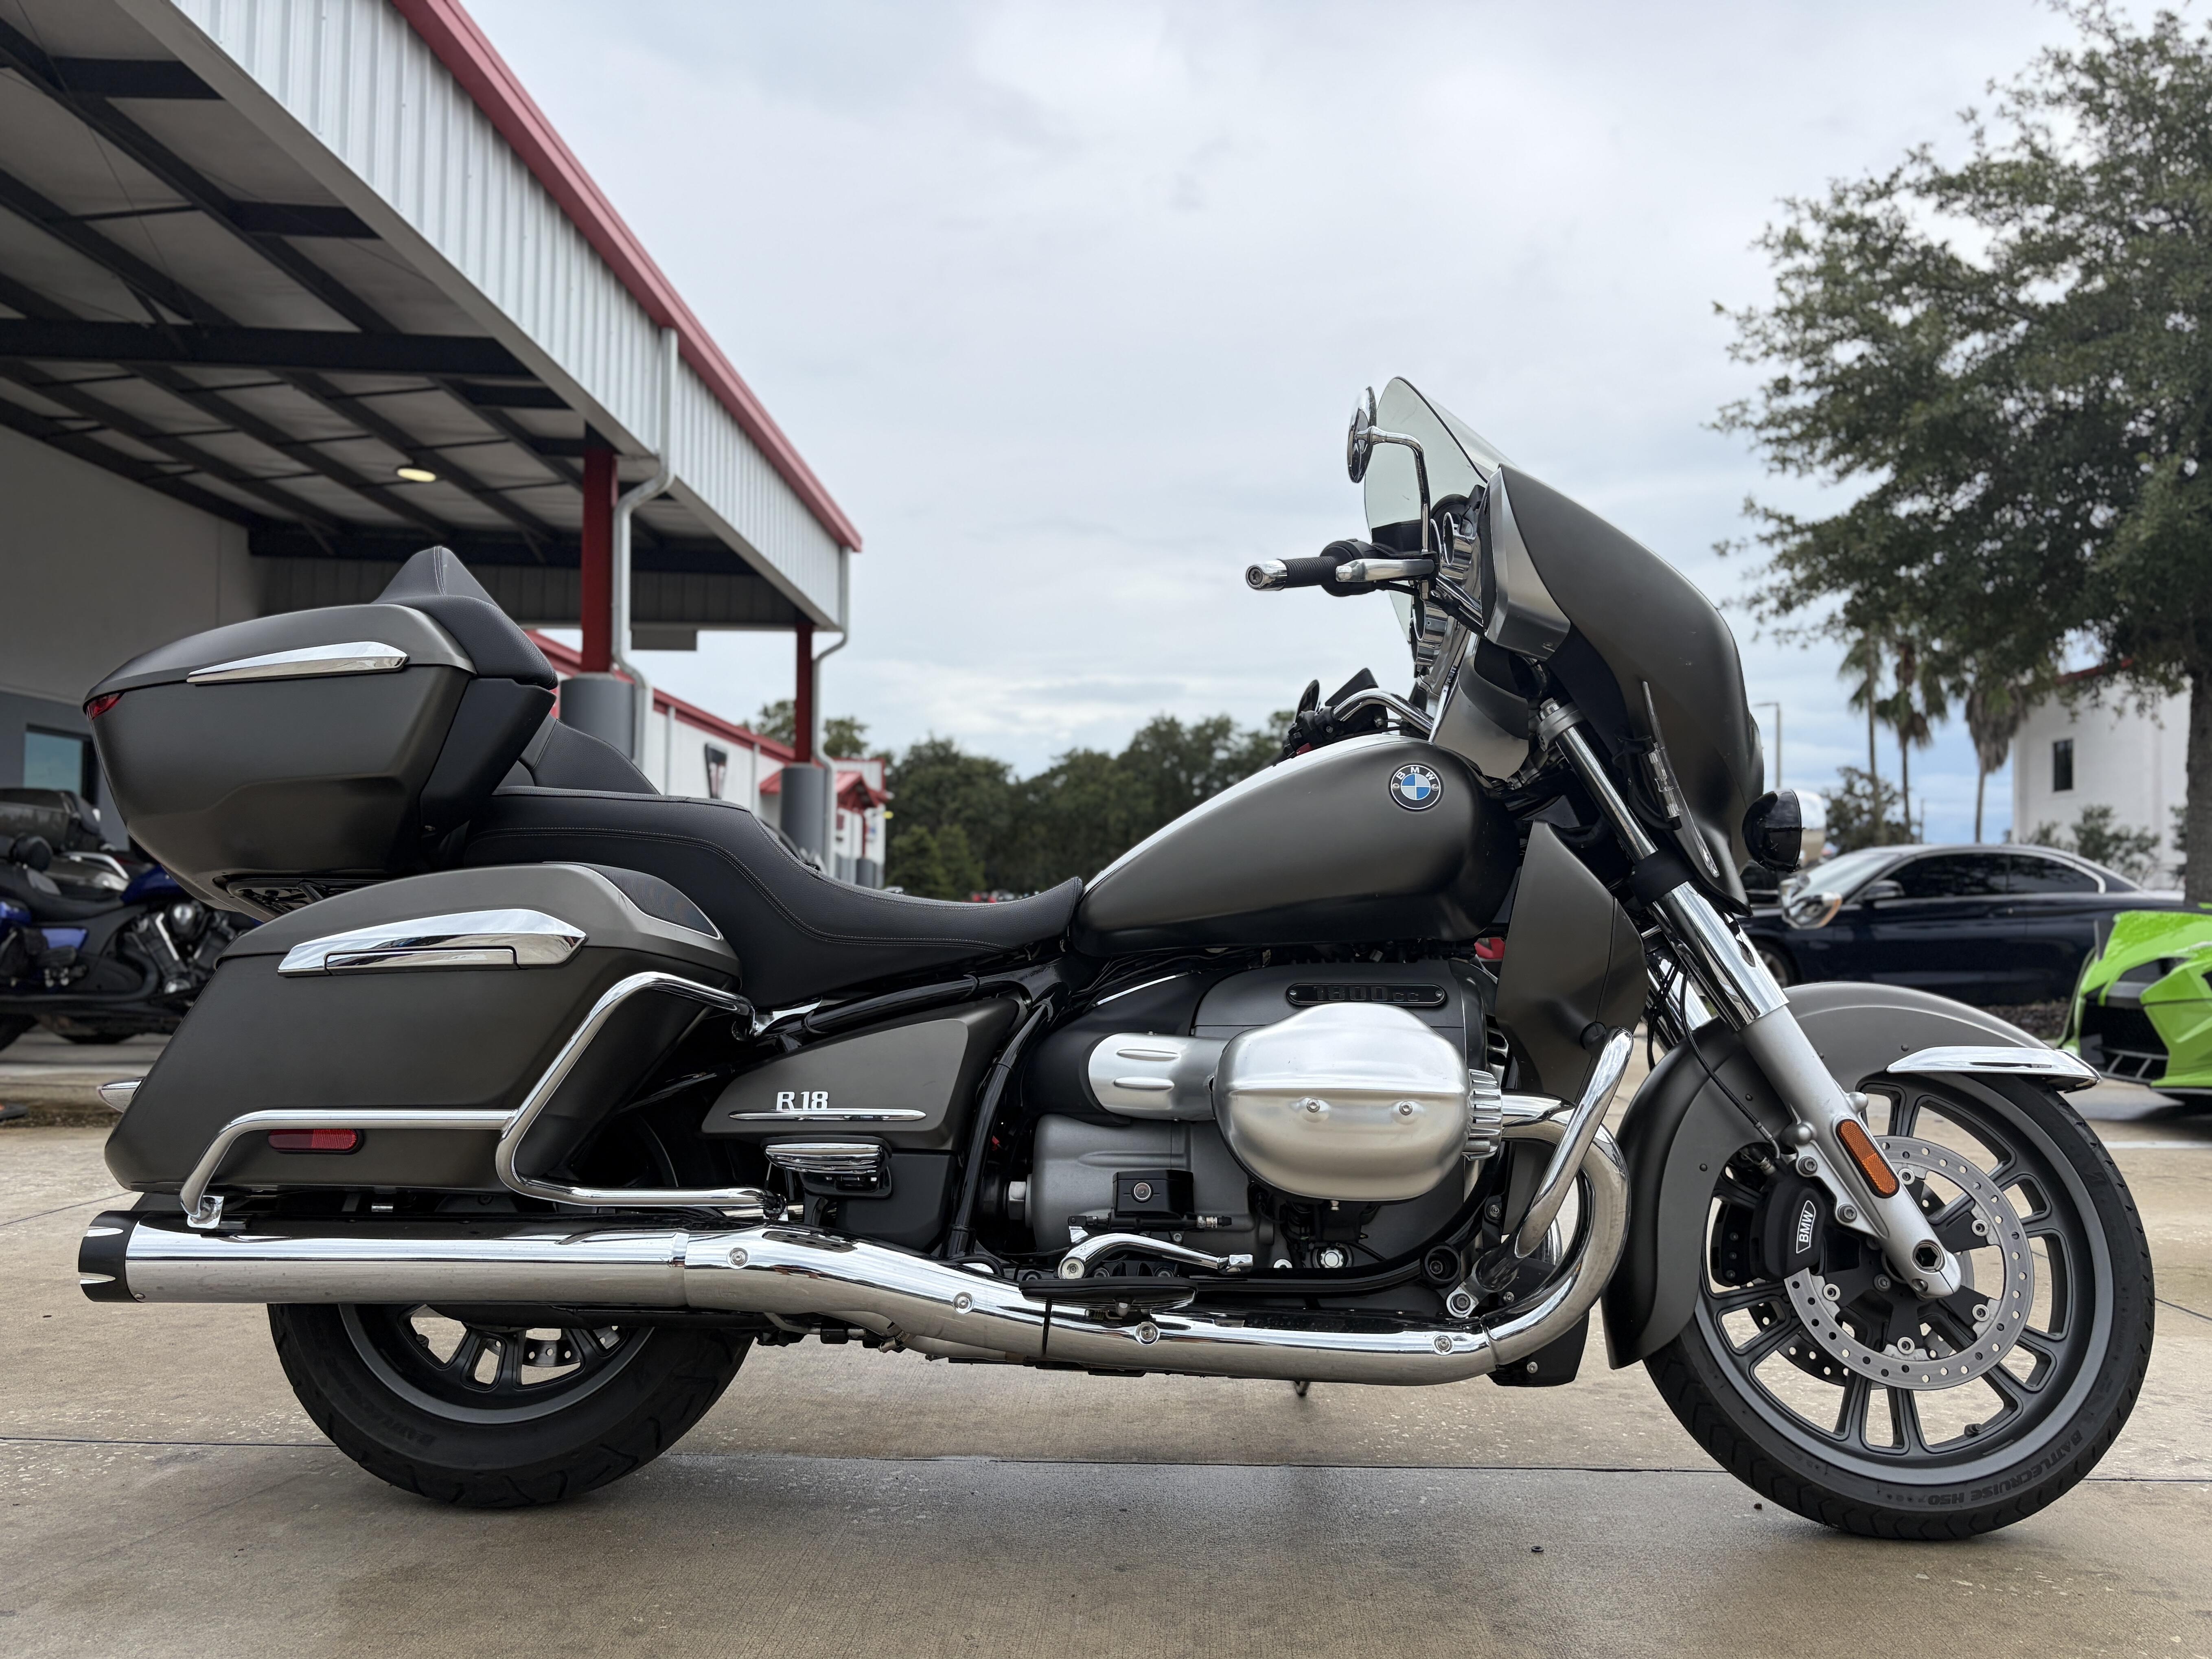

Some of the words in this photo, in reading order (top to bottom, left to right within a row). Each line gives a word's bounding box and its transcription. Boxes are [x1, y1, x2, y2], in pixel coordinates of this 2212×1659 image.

[1396, 766, 1435, 780] BMW
[1313, 987, 1388, 1001] 1800
[776, 1091, 795, 1110] R
[800, 1091, 828, 1110] 18
[1799, 1210, 1814, 1243] BMW
[1970, 1429, 2083, 1501] BATTLECRUISE
